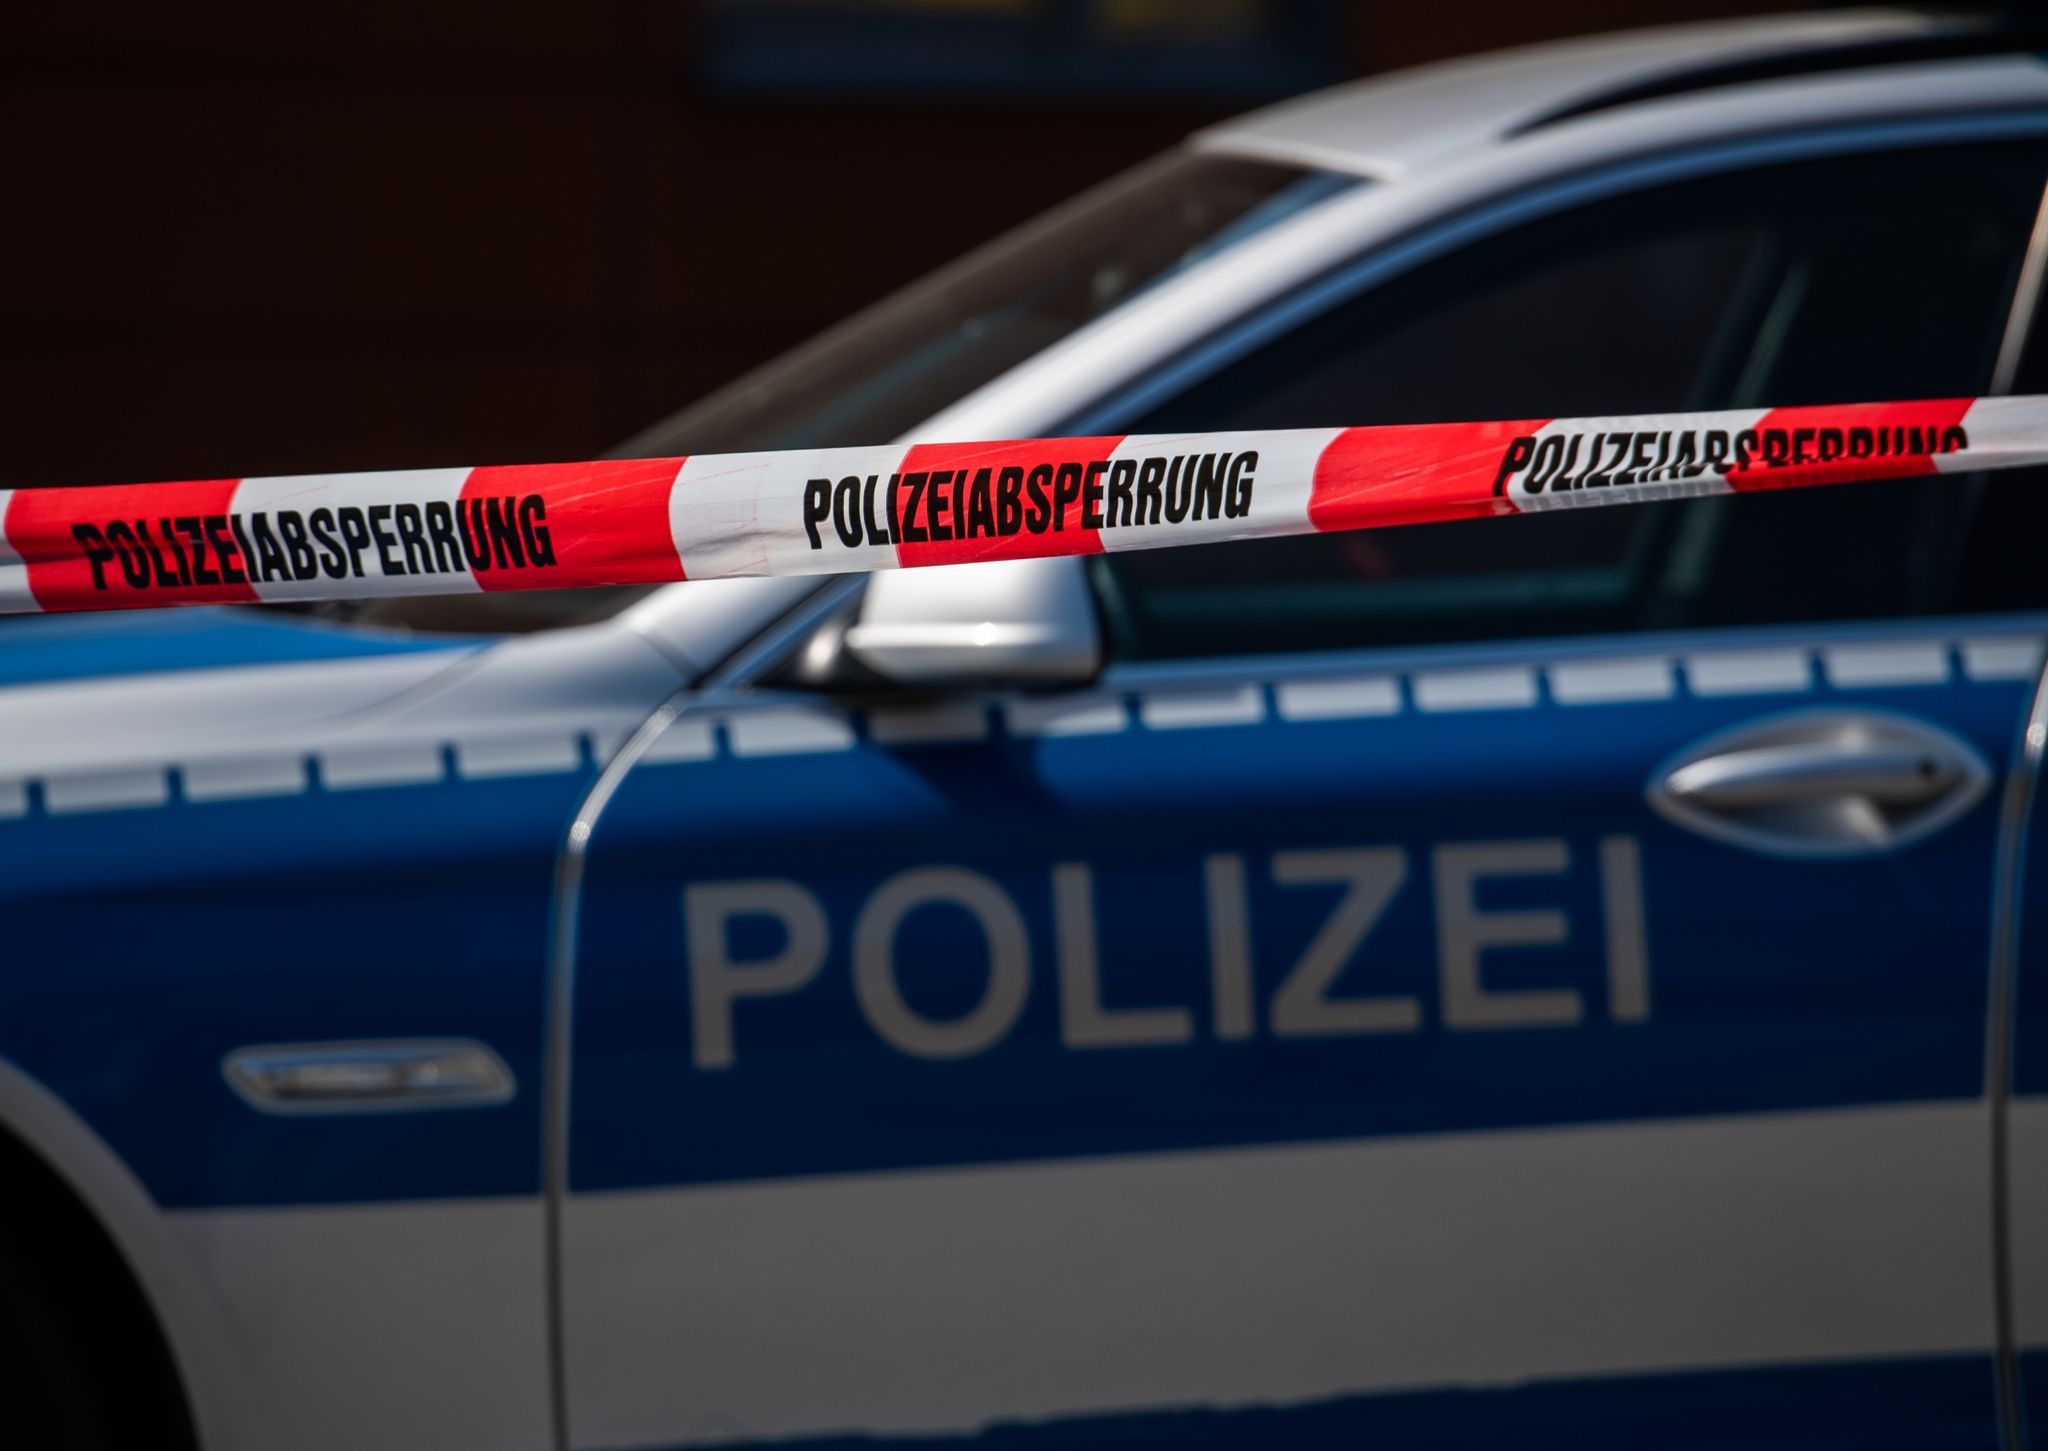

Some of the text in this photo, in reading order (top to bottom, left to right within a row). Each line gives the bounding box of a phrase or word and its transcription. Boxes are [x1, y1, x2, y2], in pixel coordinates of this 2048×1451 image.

[73, 494, 556, 590] POLIZEIABSPERRUNG
[804, 450, 1258, 550] POLIZEIABSPERRUNG
[683, 835, 1651, 1070] POLIZEI
